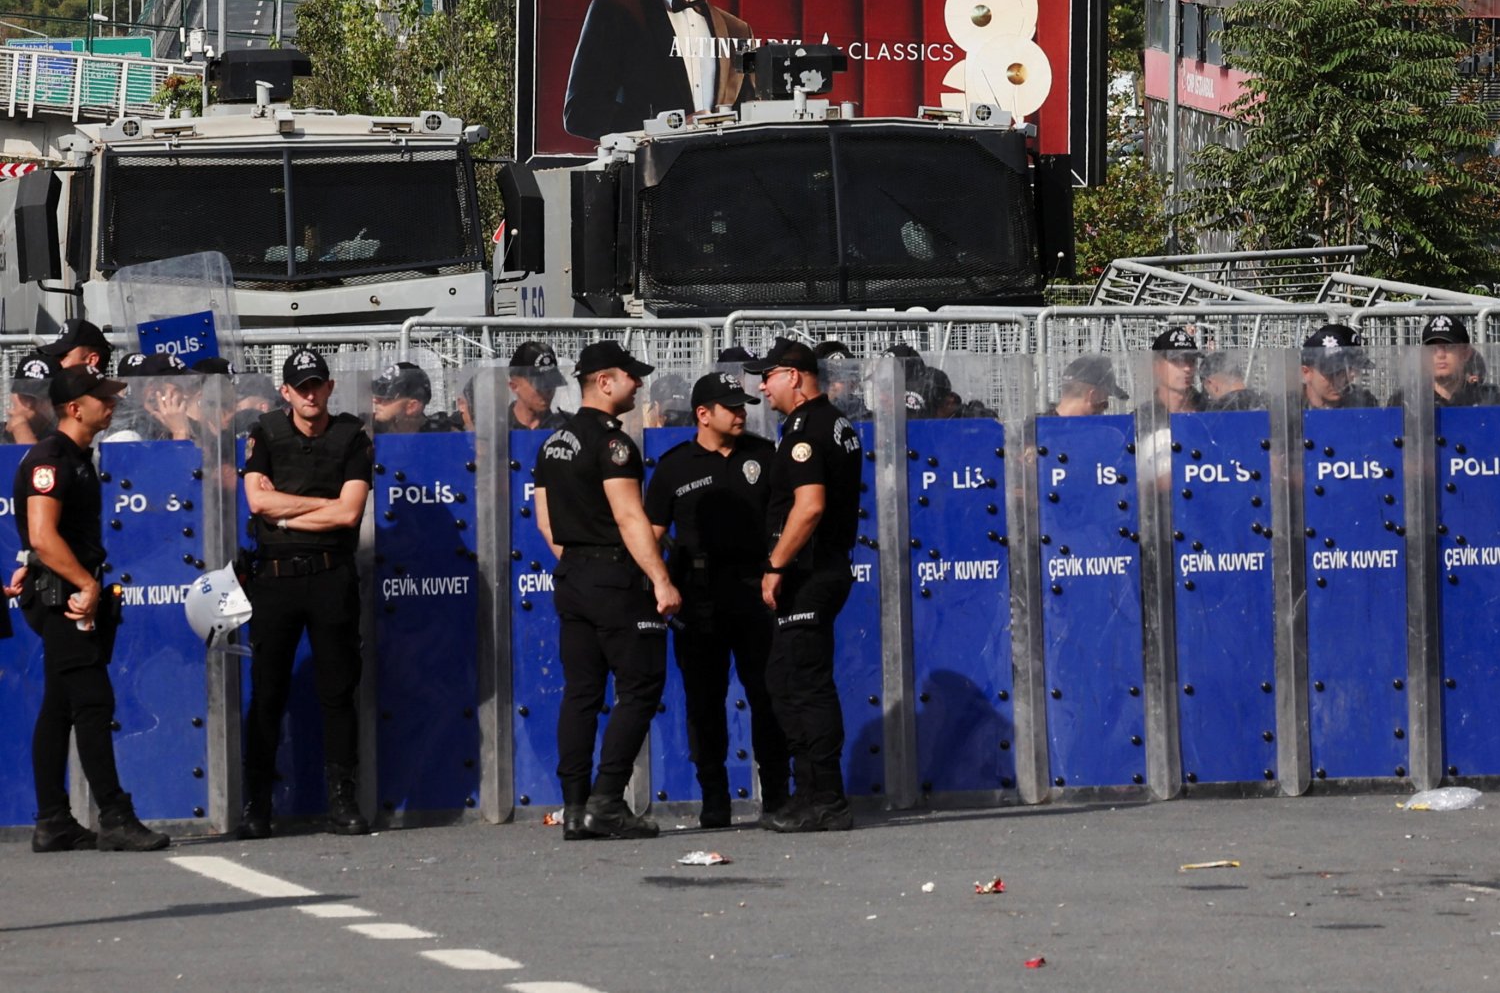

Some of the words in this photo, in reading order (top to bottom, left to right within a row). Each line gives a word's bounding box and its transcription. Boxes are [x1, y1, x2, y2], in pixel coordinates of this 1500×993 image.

[848, 42, 954, 61] CLASSICS
[389, 481, 455, 505] POLİS
[1218, 553, 1265, 571] KUVVET
[1351, 550, 1398, 569] KUVVET
[1444, 545, 1479, 570] ÇEVİK
[955, 560, 999, 580] KUVVET
[1048, 554, 1083, 582] ÇEVİK
[422, 577, 469, 595] KUVVET
[518, 569, 555, 596] ÇEVİK
